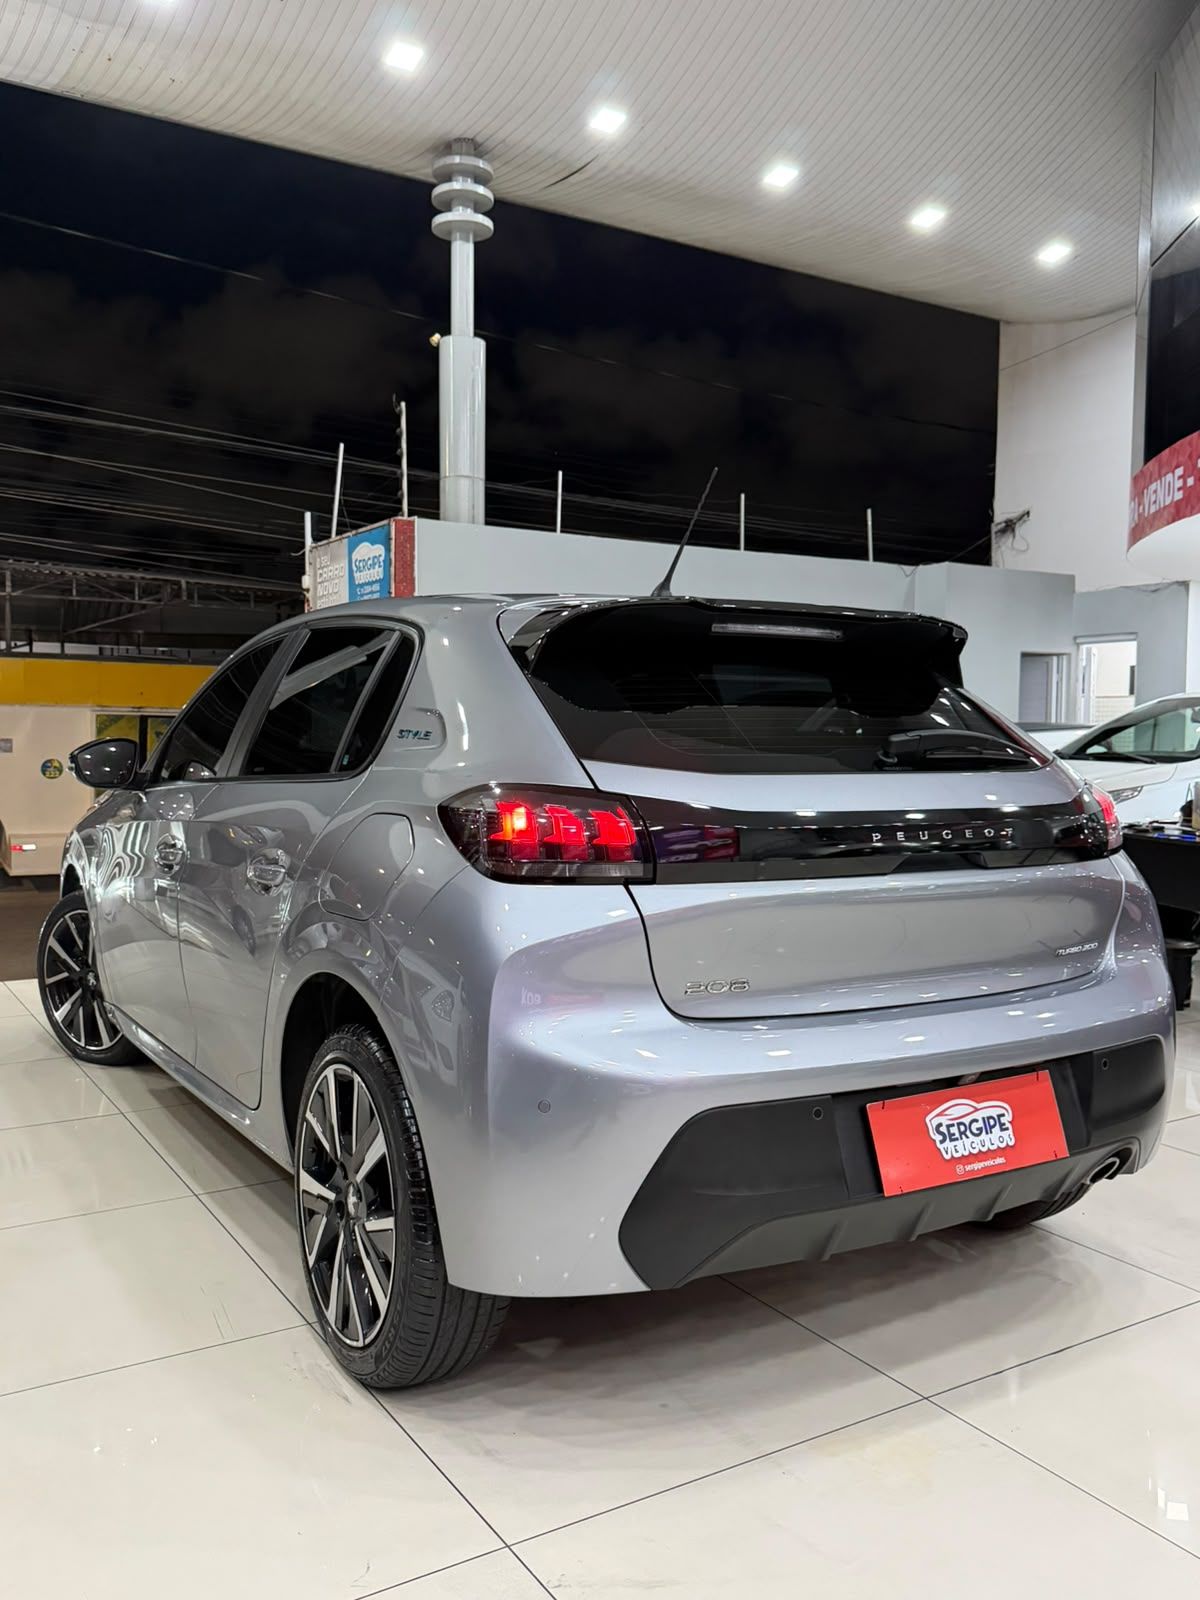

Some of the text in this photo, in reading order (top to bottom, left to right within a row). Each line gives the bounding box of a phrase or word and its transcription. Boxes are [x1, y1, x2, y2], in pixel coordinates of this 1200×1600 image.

[1144, 466, 1184, 517] VENDE
[353, 554, 383, 574] SERGIPE
[317, 564, 345, 582] CARRO
[317, 581, 339, 597] NOVO
[397, 729, 433, 740] STYLE
[872, 828, 1013, 841] PEUGEOT
[1056, 942, 1098, 956] TURBO 200
[685, 978, 750, 995] 208
[934, 1113, 1010, 1144] SERGIPE
[943, 1134, 1012, 1155] VEÍCULOS
[964, 1157, 1006, 1171] sergipeveiculos
